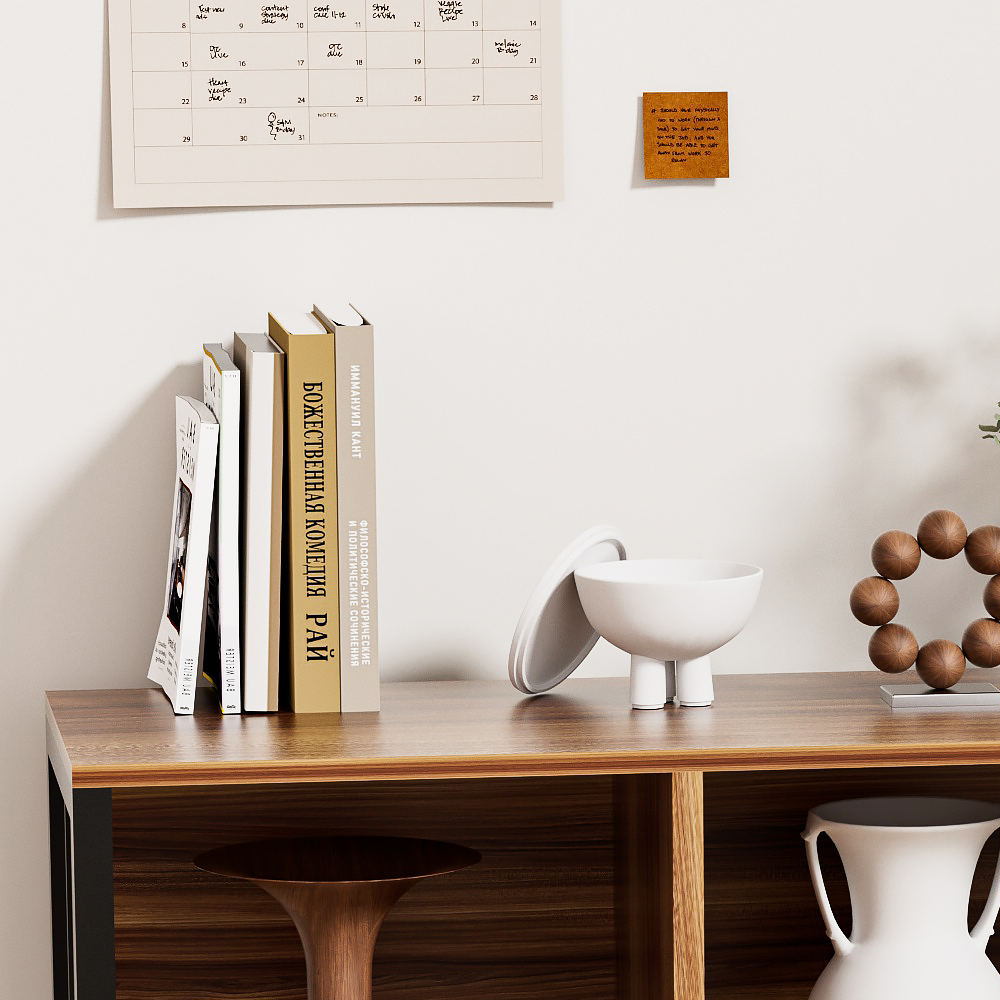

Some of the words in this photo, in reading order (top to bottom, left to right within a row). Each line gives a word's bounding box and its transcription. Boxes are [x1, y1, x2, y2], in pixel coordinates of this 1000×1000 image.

[350, 365, 361, 426] ИММАНУИЛ
[303, 382, 324, 513] БОЖЕСТВЕННАЯ
[352, 432, 361, 458] КАНТ
[303, 519, 326, 597] КОМЕДИЯ
[348, 530, 359, 607] ПОЛИТИЧЕСКИЕ
[358, 519, 371, 666] ФИЛОСОФСКО-ИСТОРИЧЕСКИЕ
[306, 613, 334, 661] РАЙ
[349, 609, 360, 667] СОЧИНЕНИЯ
